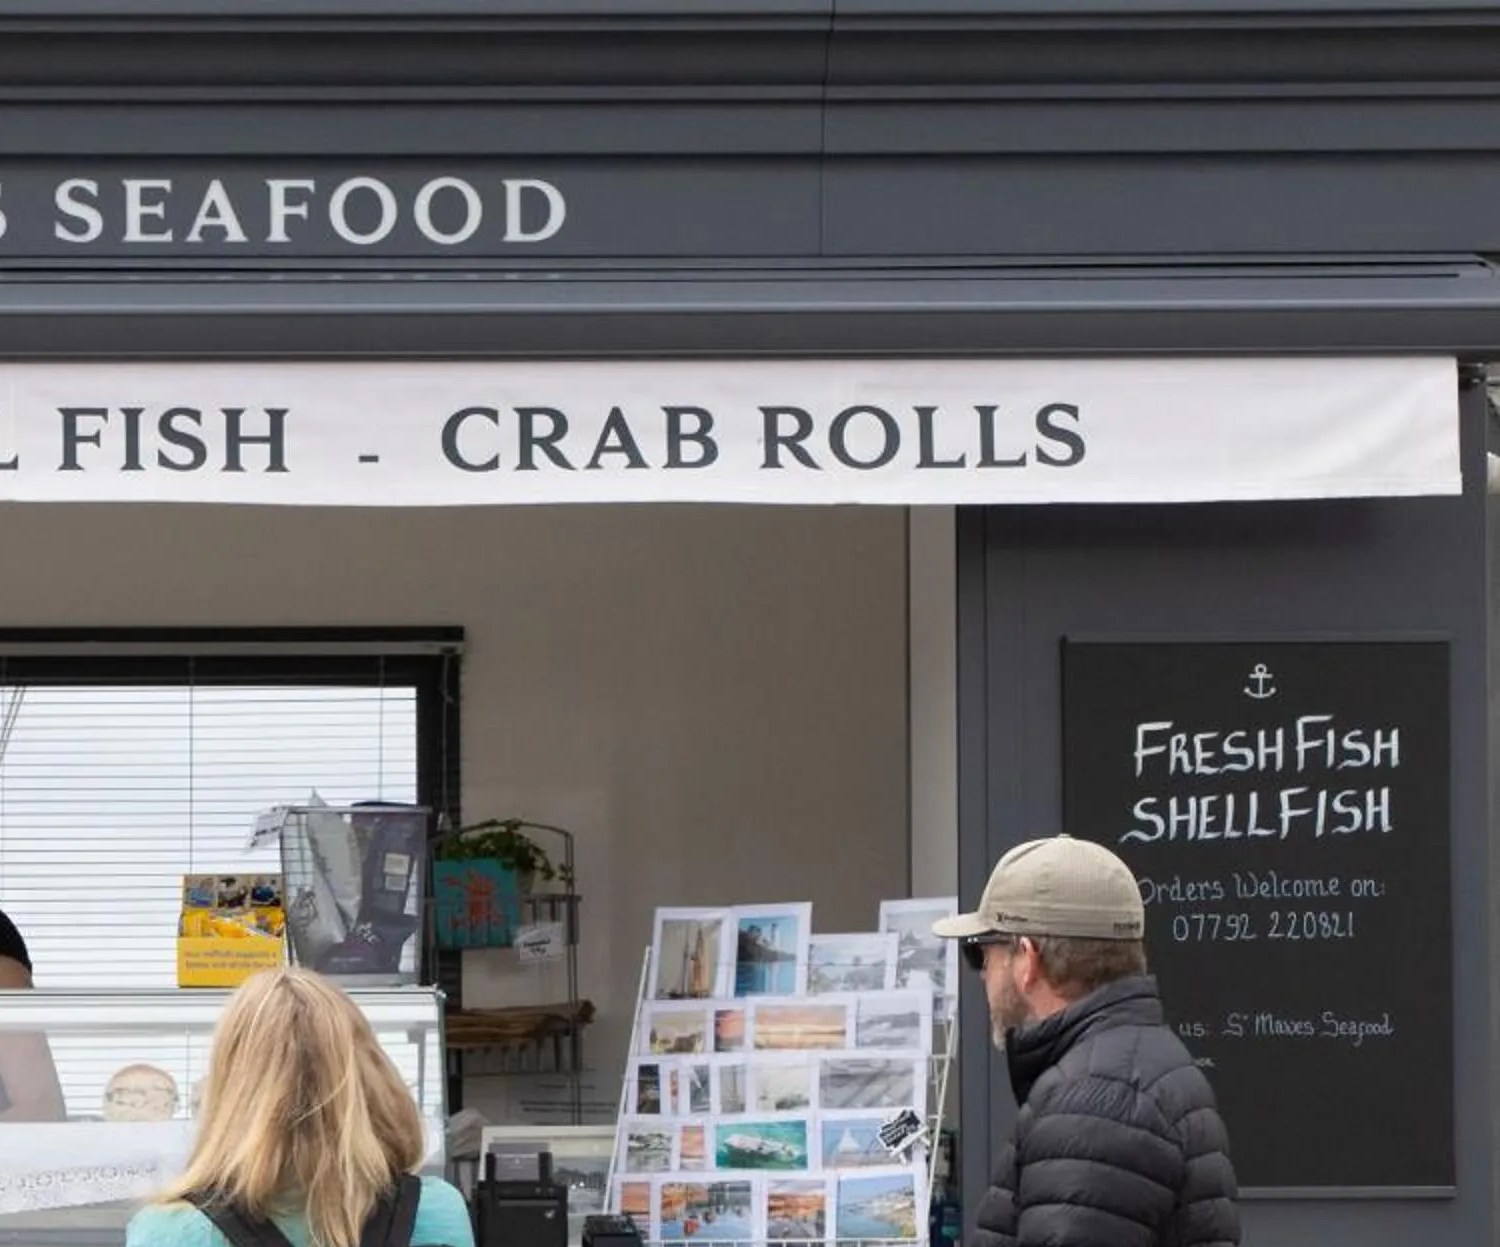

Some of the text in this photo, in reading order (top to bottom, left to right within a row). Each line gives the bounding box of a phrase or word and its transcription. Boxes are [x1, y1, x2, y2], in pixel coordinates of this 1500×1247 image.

[54, 176, 567, 245] SEAFOOD
[57, 406, 290, 473] FISH
[441, 405, 719, 473] CRAB
[757, 402, 1086, 471] ROLLS
[1133, 715, 1399, 777] FRESH FISH
[1233, 870, 1341, 898] Welcome
[1172, 911, 1354, 942] 07792 220821
[1321, 1010, 1394, 1047] Seafood
